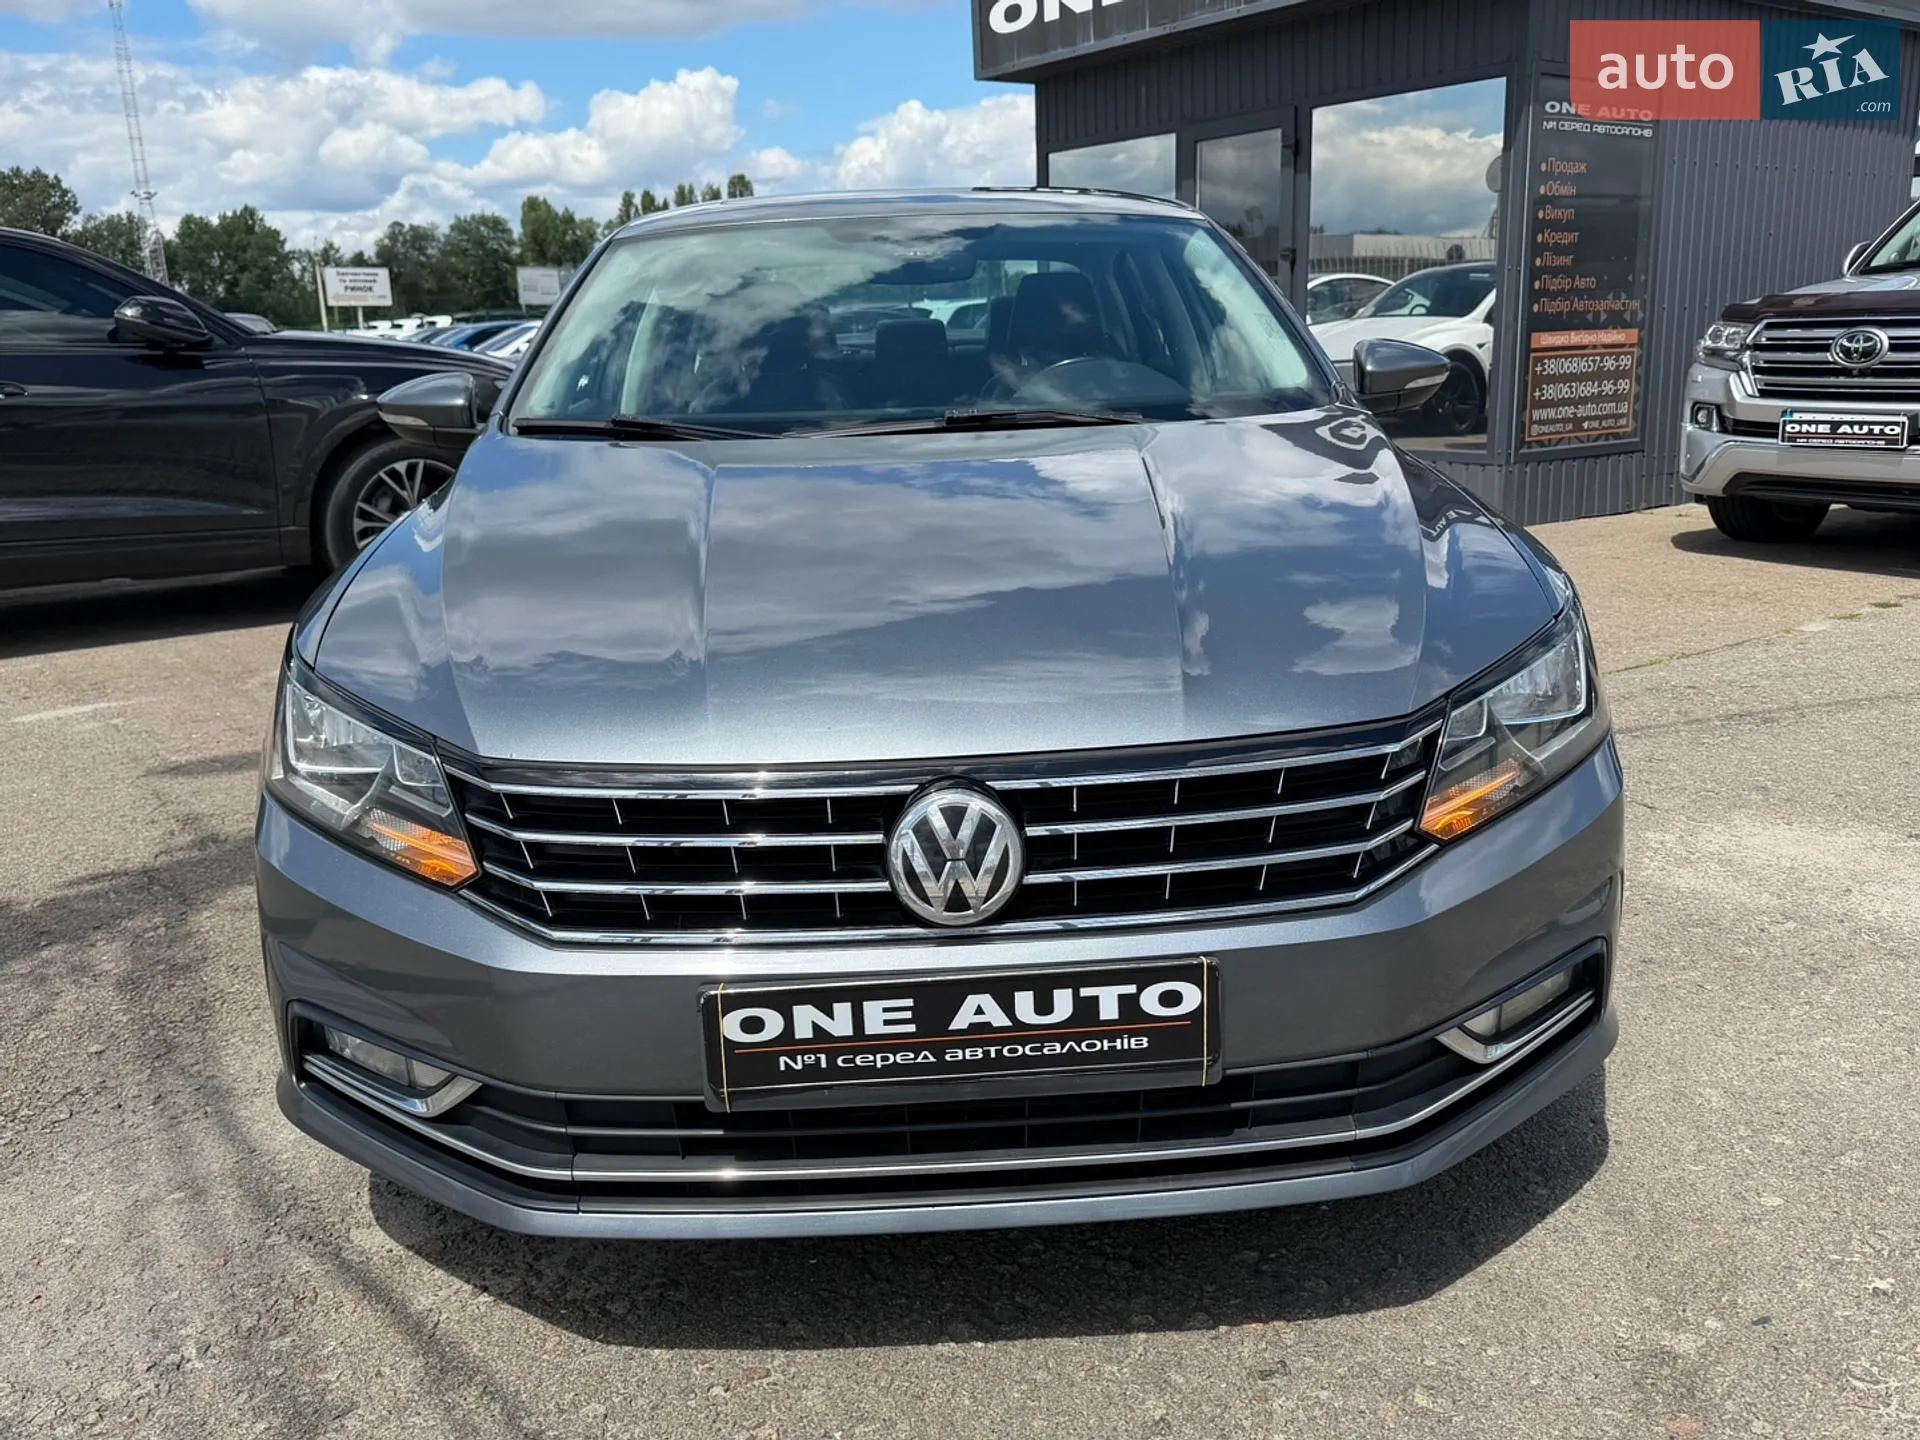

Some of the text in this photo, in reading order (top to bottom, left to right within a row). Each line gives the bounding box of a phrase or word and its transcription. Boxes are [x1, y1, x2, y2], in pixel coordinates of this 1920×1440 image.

[1544, 101, 1653, 121] ONE AUTO
[1547, 157, 1588, 176] Продаж
[1546, 181, 1577, 197] Обмін
[1545, 204, 1575, 223] Викуп
[1543, 228, 1579, 246] Кредит
[1541, 252, 1575, 267] Лізинг
[1541, 274, 1597, 292] Підбір Авто
[1540, 297, 1641, 314] Підбір Автозапчастин
[1534, 355, 1632, 376] +38(068)657-96-99
[1533, 379, 1631, 400] +38(063)684-96-99
[1532, 402, 1628, 420] www.one-auto.com.ua
[1785, 424, 1900, 435] ONE AUTO
[723, 981, 1202, 1043] ONE AUTO
[778, 1053, 827, 1071] №1
